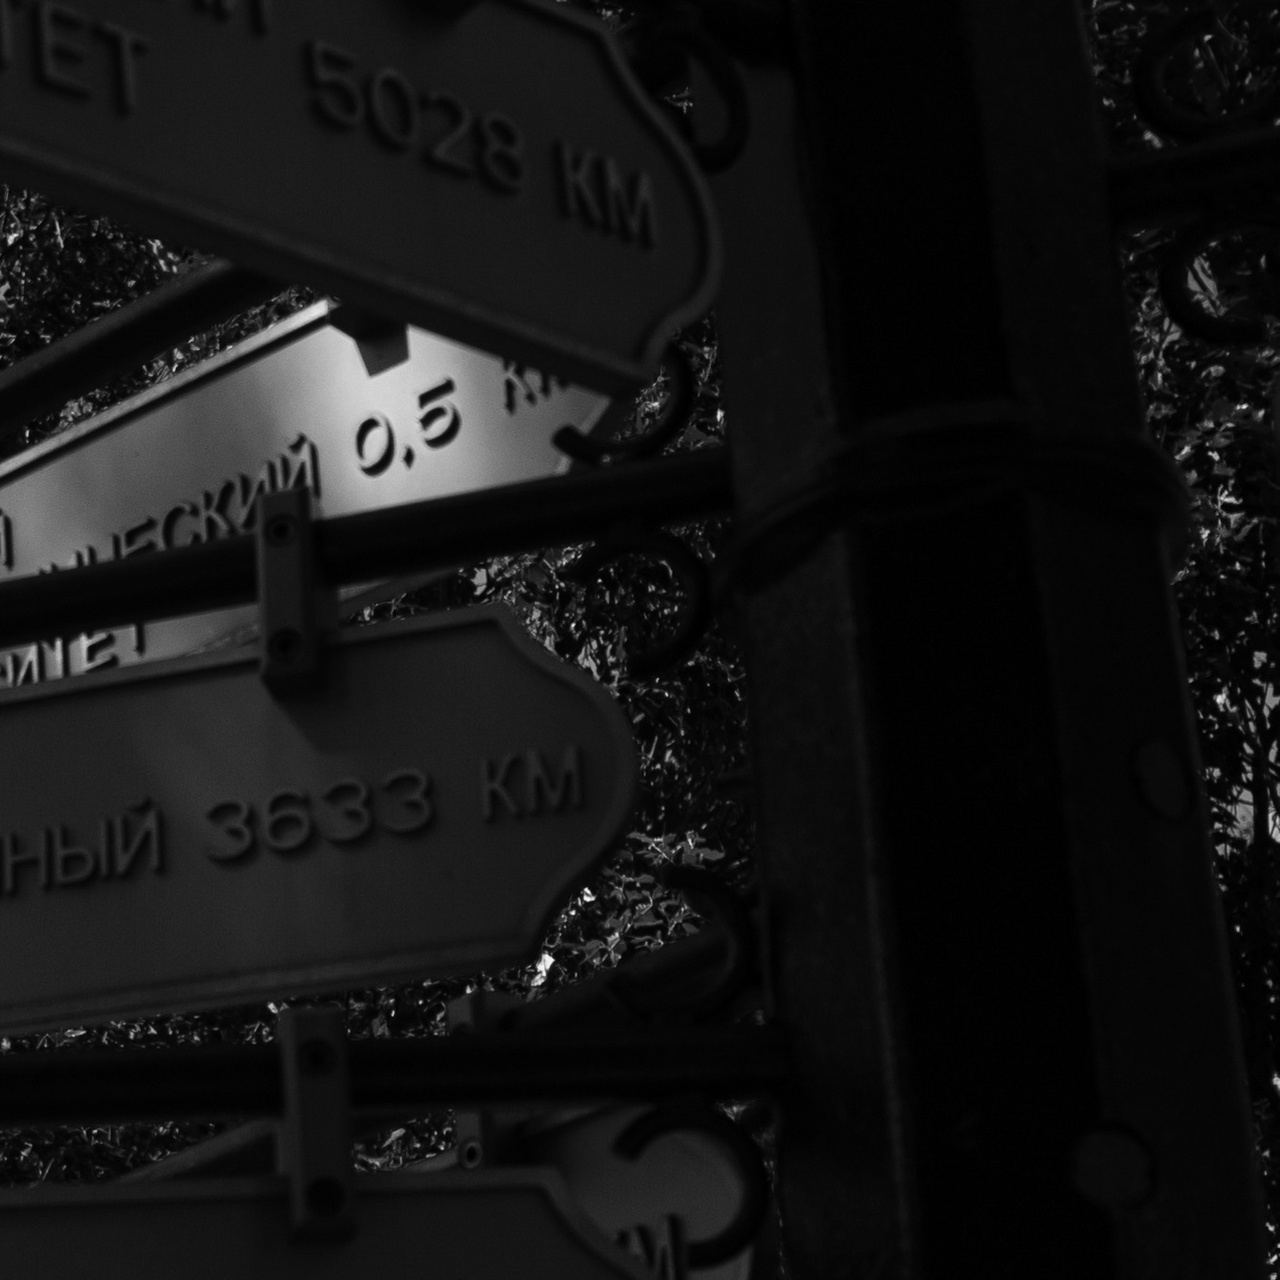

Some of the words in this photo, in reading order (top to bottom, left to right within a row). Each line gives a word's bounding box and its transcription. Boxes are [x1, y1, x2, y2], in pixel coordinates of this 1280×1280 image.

[303, 38, 521, 192] 5028
[552, 138, 660, 252] КМ
[355, 376, 461, 478] 0,5
[204, 765, 437, 864] 3633
[478, 744, 587, 824] КМ
